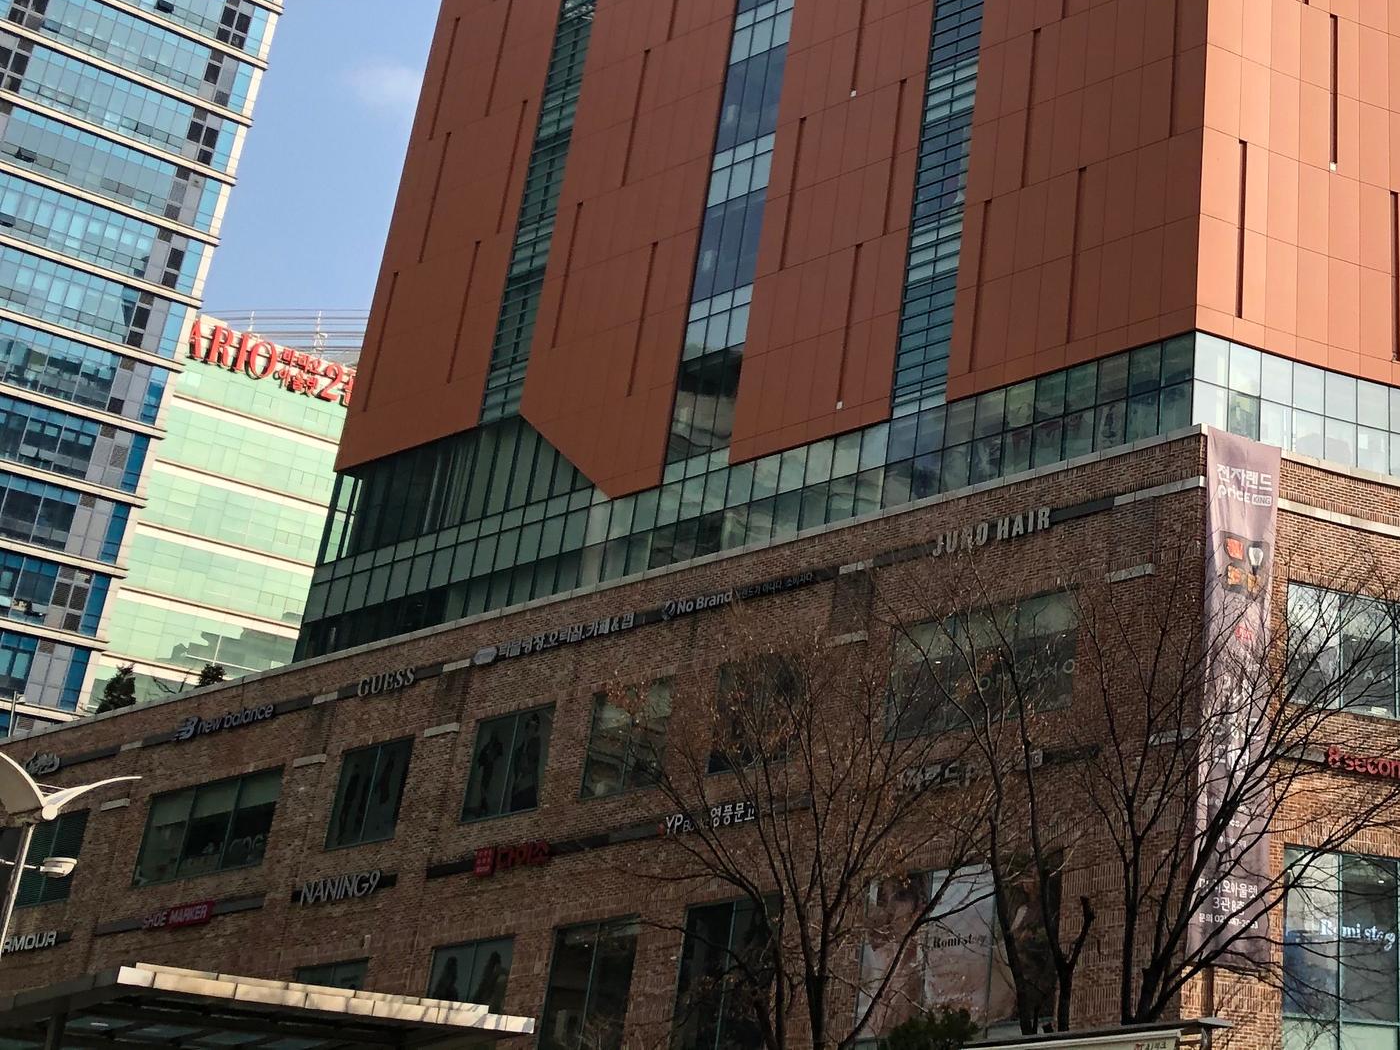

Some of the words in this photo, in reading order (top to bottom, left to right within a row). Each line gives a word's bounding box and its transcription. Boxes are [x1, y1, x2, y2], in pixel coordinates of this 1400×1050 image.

[1216, 463, 1273, 492] 전자랜드
[933, 523, 989, 557] JUNO
[996, 507, 1051, 541] HAIR
[677, 600, 694, 615] No
[696, 588, 733, 610] Brand
[357, 667, 416, 698] GUESS
[198, 717, 222, 736] new
[222, 703, 275, 730] balance
[300, 869, 382, 907] NANING9
[143, 910, 168, 929] SHOE
[169, 903, 208, 924] MARKER
